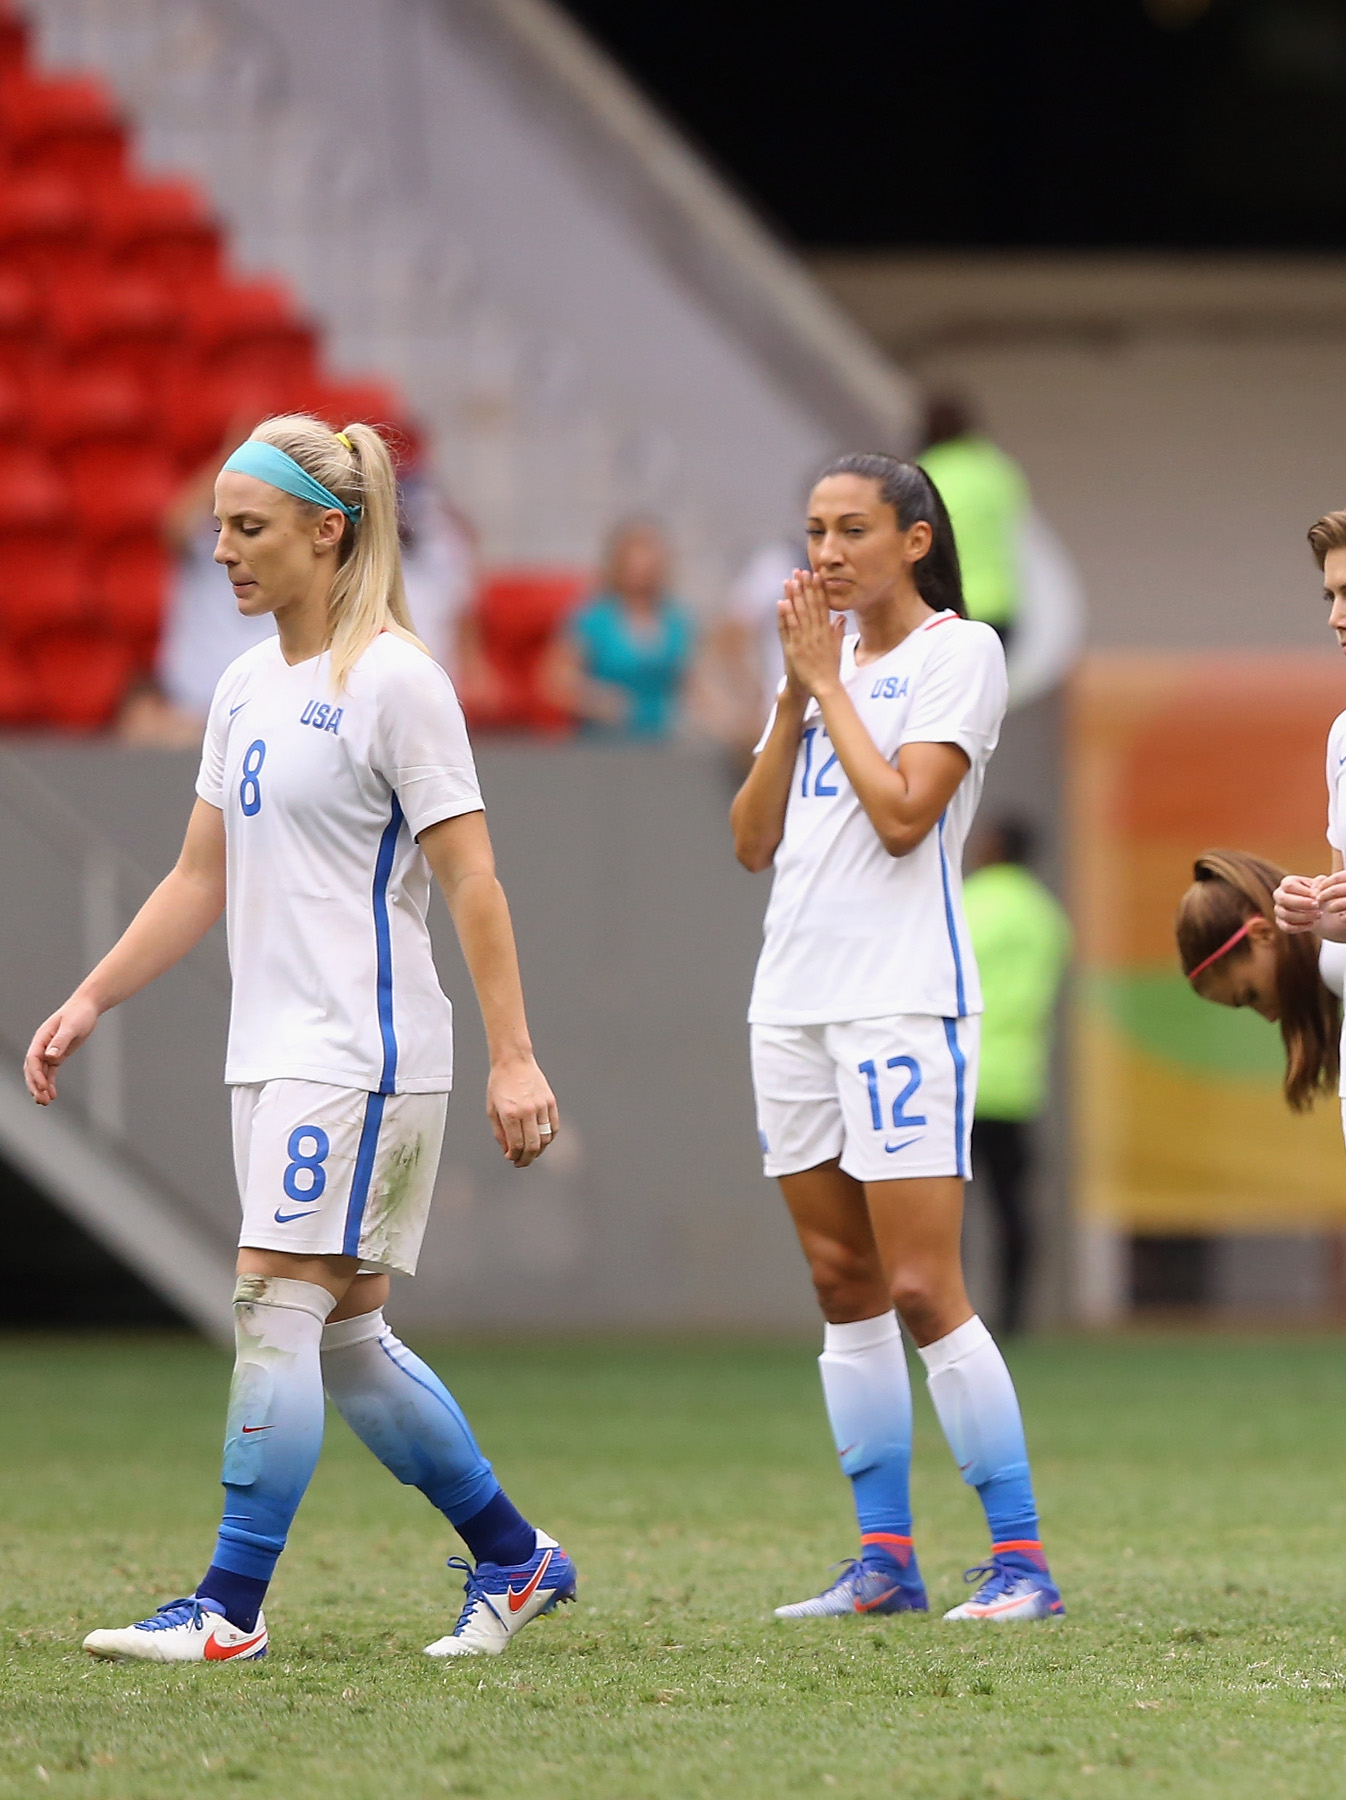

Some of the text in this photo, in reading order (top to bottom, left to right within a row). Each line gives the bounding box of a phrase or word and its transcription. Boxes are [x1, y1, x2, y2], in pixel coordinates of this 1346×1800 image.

[300, 699, 345, 736] USA
[871, 676, 910, 699] USA
[239, 739, 266, 817] 8
[801, 727, 840, 798] 12
[858, 1054, 928, 1131] 12
[283, 1124, 330, 1203] 8
